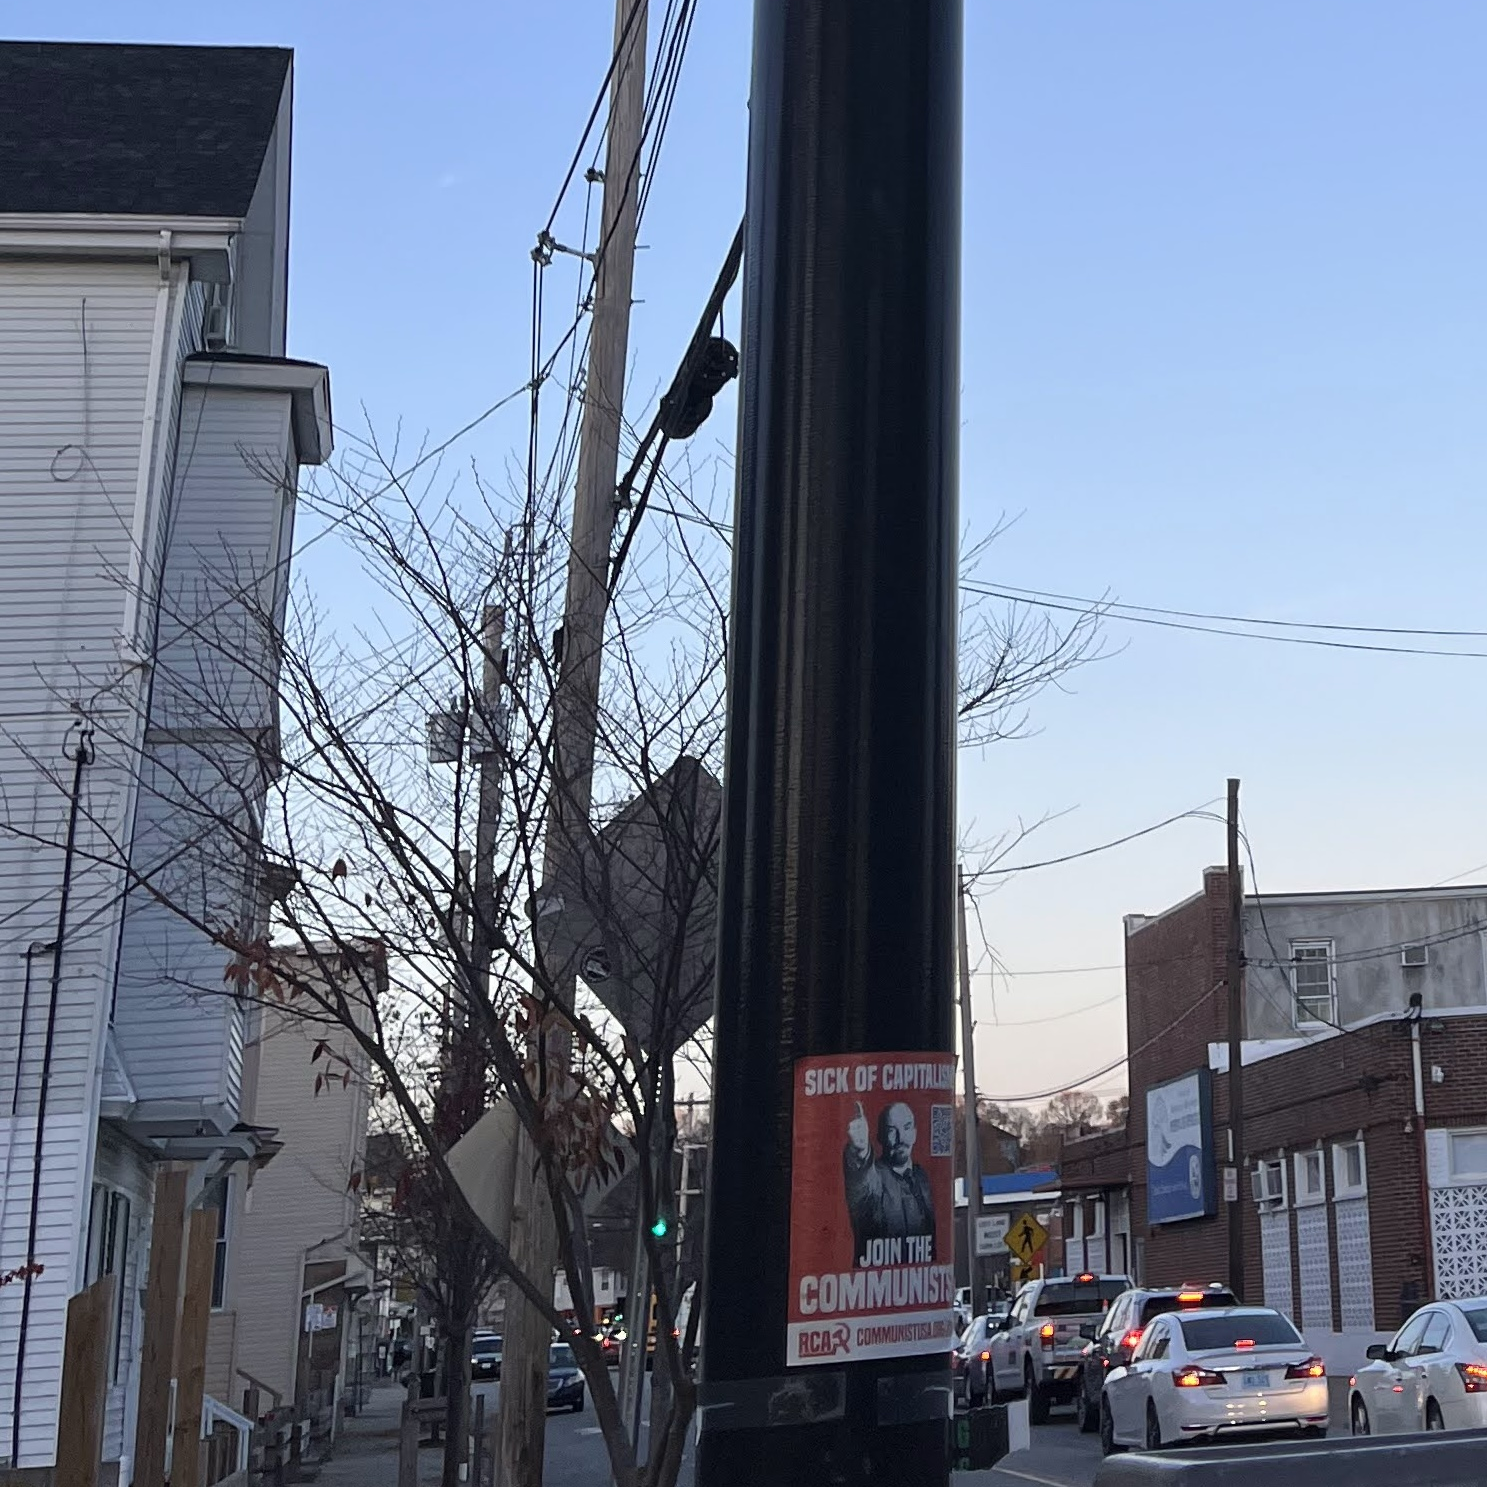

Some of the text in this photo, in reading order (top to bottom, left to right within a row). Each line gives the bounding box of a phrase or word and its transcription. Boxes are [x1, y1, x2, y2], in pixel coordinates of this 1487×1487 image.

[804, 1067, 849, 1096] SICK
[854, 1065, 878, 1092] OF
[859, 1235, 932, 1268] JOIN THE
[798, 1330, 832, 1355] RCA
